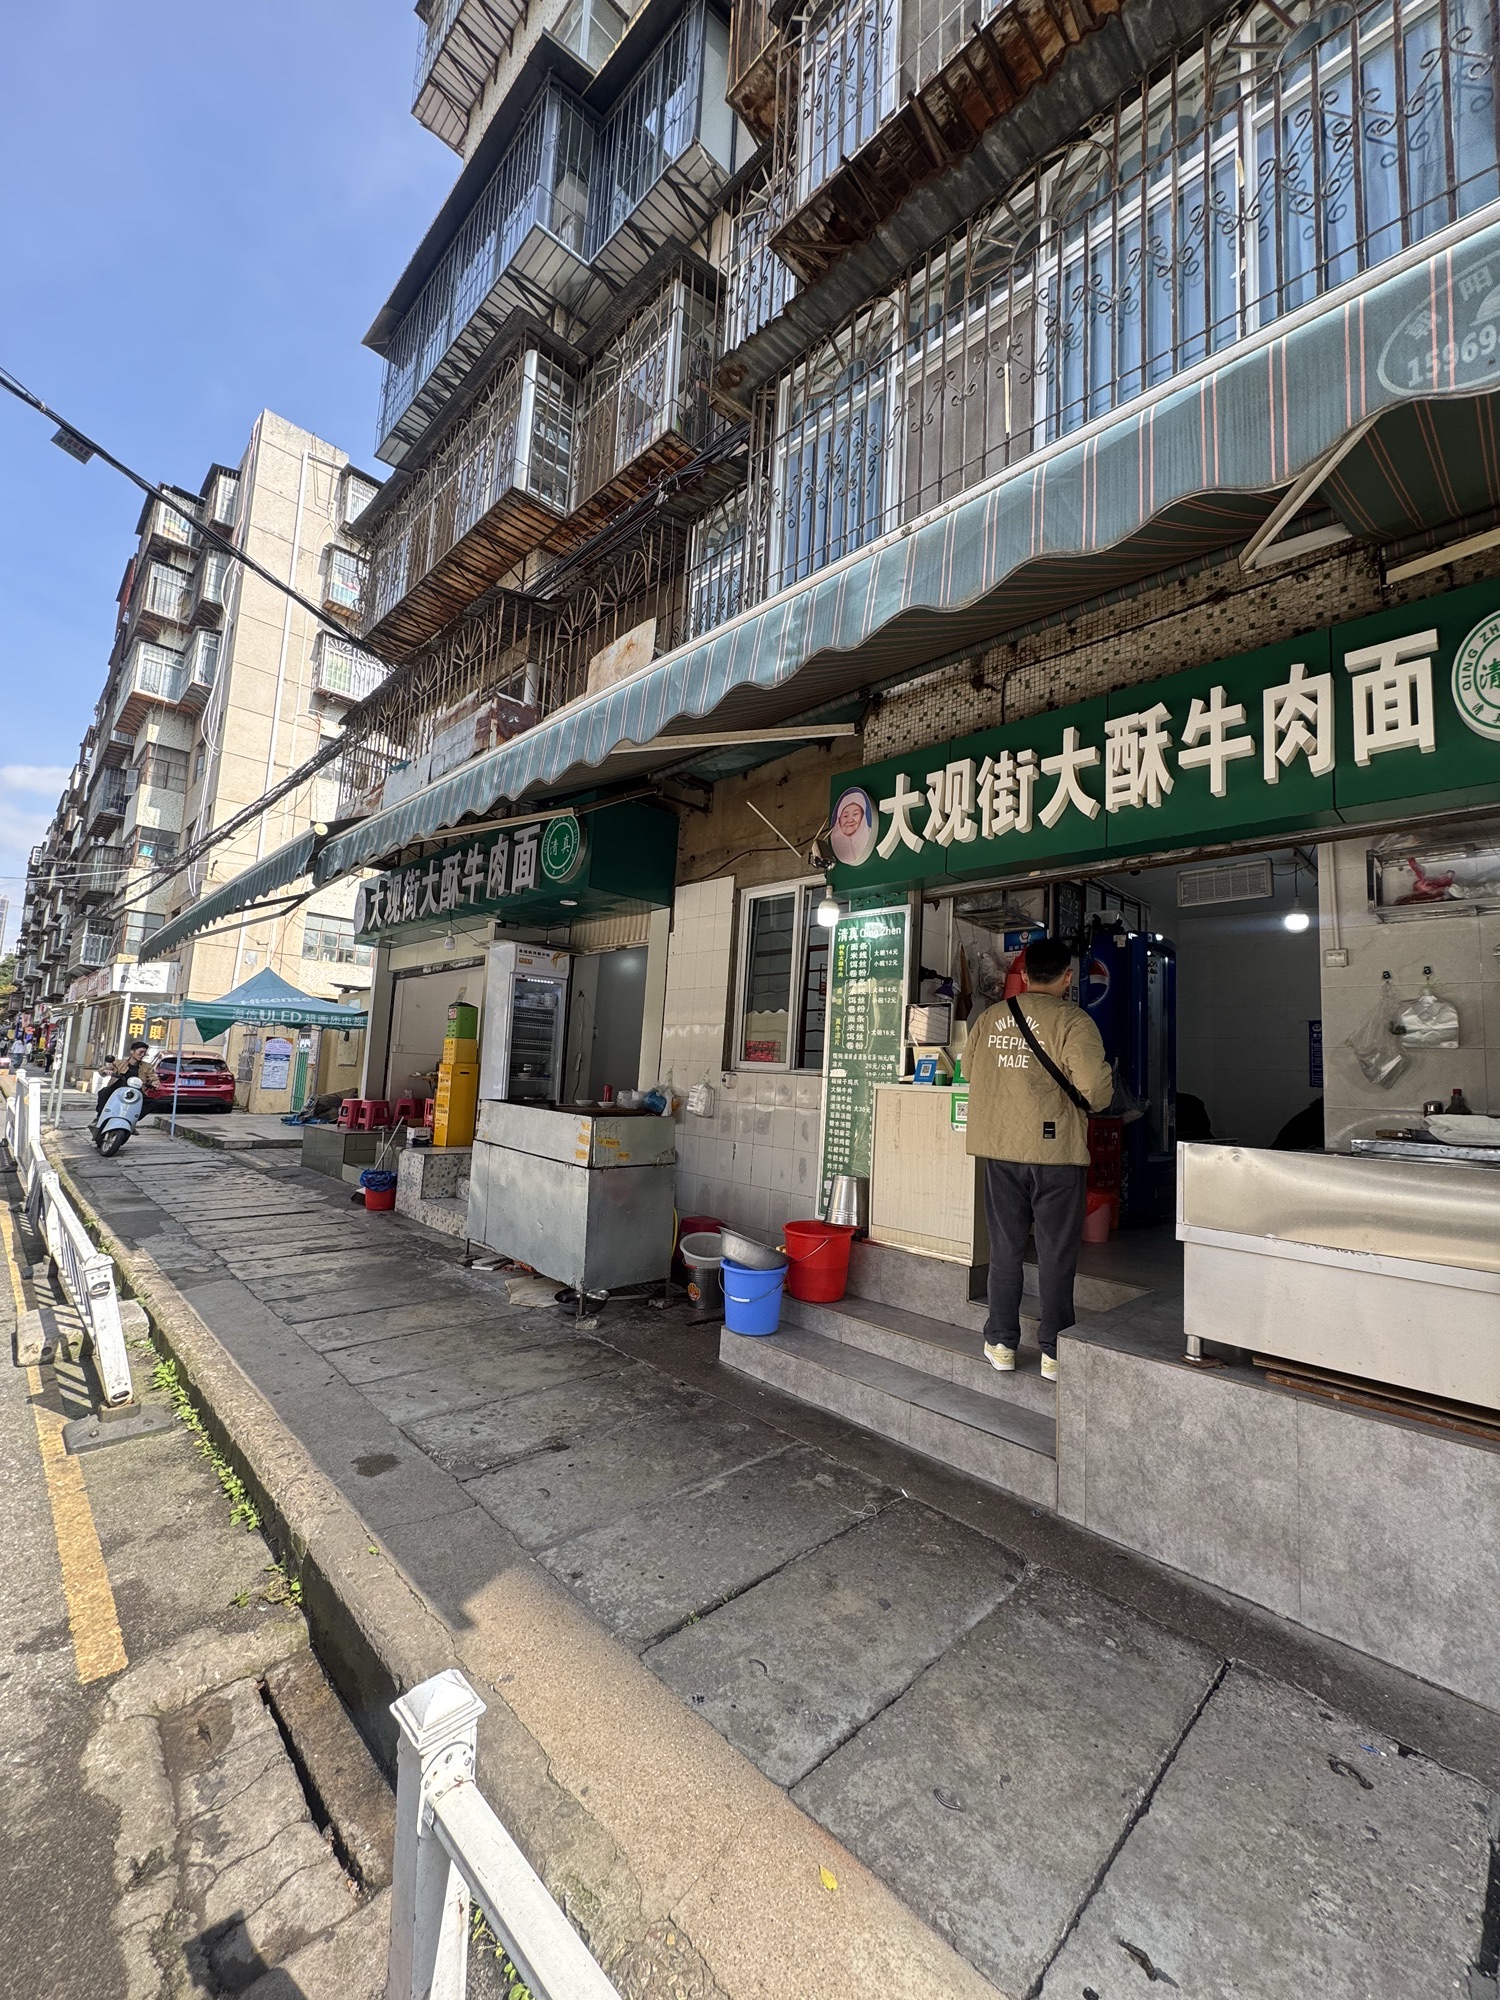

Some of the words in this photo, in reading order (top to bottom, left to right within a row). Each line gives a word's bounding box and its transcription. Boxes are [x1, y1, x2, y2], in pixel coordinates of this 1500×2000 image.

[1408, 325, 1500, 387] 15969
[1462, 649, 1478, 691] QING
[1479, 624, 1500, 643] ZH
[877, 629, 1439, 859] 大观街大酥牛肉面
[550, 833, 571, 856] 清真
[367, 824, 541, 931] 大观街大酥牛肉面
[838, 927, 859, 941] 清真
[880, 927, 901, 936] Zhen
[850, 943, 867, 951] 面条
[850, 951, 867, 960] 米线
[849, 960, 867, 968] 饵丝
[849, 969, 867, 977] 卷粉
[241, 997, 312, 1005] Hisense
[847, 1005, 865, 1013] 卷粉
[260, 1009, 302, 1022] ULED
[847, 1015, 865, 1023] 面条
[129, 1005, 147, 1039] 美甲
[847, 1024, 865, 1032] 米线
[846, 1033, 864, 1041] 饵丝
[846, 1041, 864, 1050] 卷粉
[998, 1054, 1030, 1068] MADE
